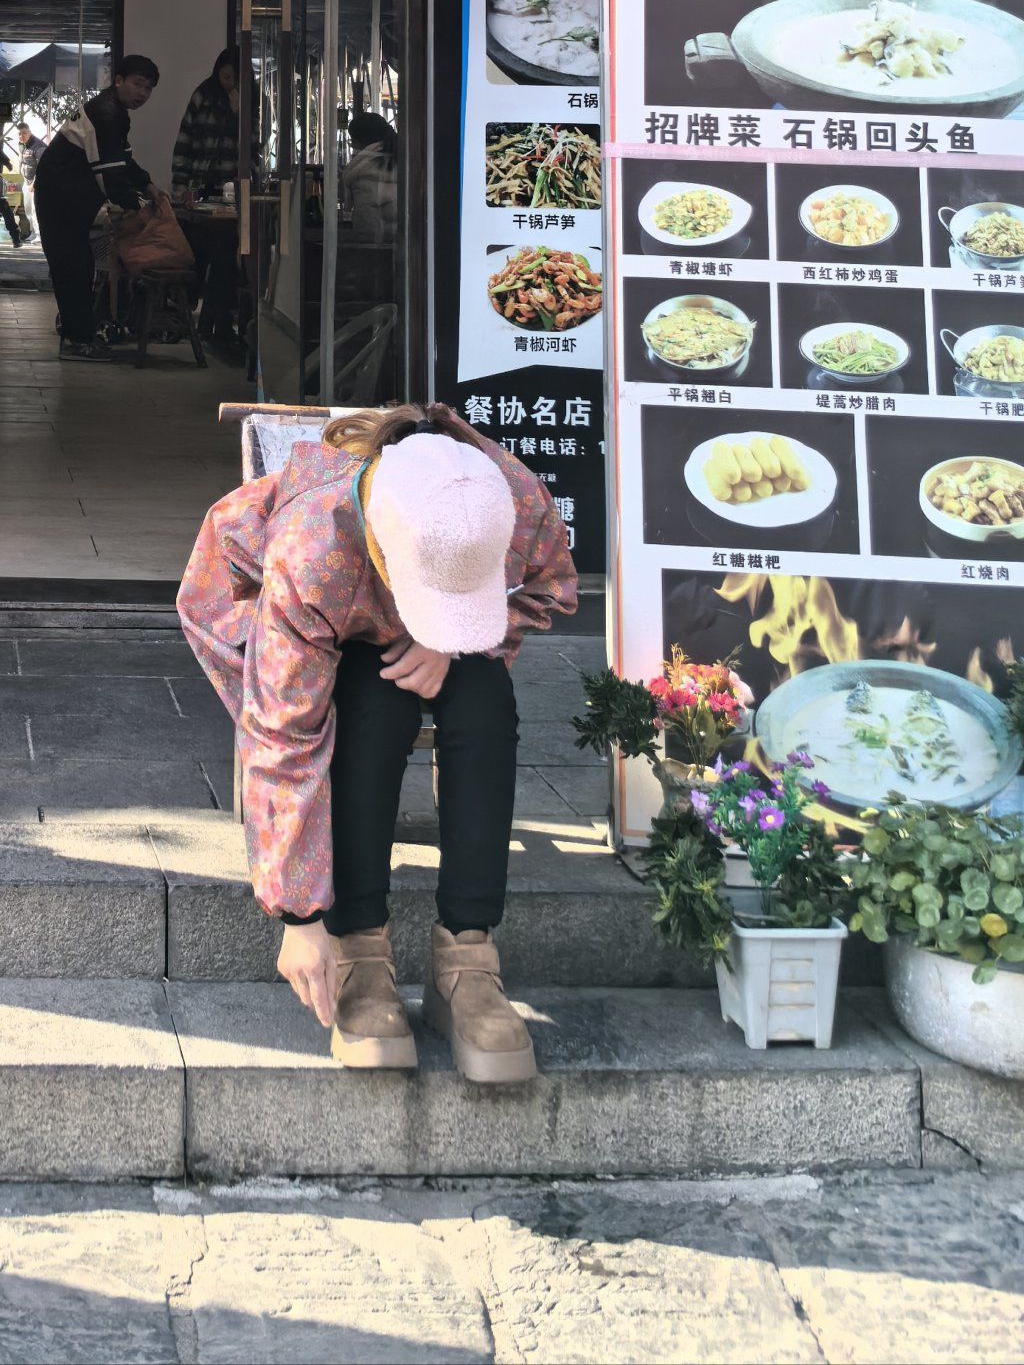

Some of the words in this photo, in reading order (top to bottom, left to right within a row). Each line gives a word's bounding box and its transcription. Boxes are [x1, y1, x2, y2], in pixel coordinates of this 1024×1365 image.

[567, 92, 599, 109] 石锅
[644, 111, 761, 148] 招牌菜
[782, 117, 978, 154] 石锅回头鱼
[512, 214, 576, 230] 干锅芦笋
[668, 260, 733, 277] 青椒塘虾
[802, 266, 899, 284] 西红柿炒鸡蛋
[514, 336, 577, 353] 青椒河虾
[668, 387, 732, 404] 平锅翘白
[816, 393, 896, 412] 堤蒿炒腊肉
[464, 394, 592, 427] 餐协名店
[712, 551, 781, 570] 红糖糍粑
[960, 563, 1010, 581] 红烧肉
